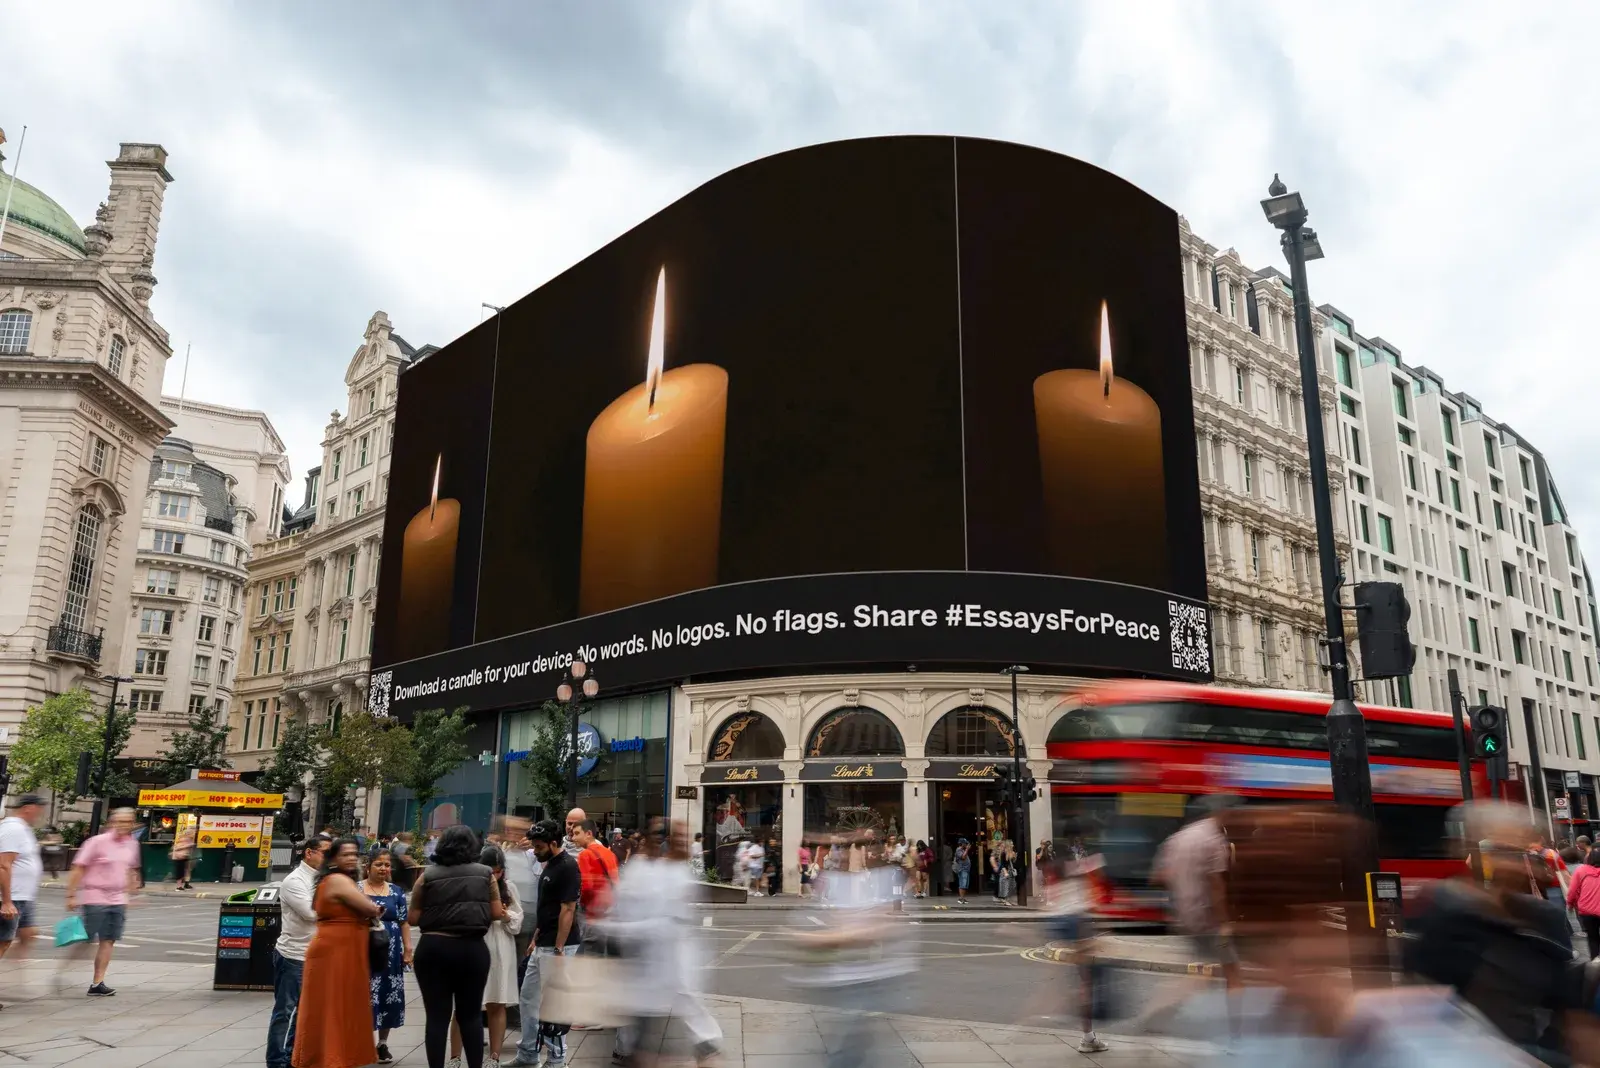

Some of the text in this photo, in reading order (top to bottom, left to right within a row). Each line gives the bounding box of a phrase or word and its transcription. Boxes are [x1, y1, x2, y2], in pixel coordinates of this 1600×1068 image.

[79, 400, 134, 444] ALLIANCE LIFE OFFICE
[394, 676, 439, 701] Download
[441, 678, 446, 692] a
[448, 668, 482, 690] candle
[484, 665, 501, 683] for
[503, 661, 530, 683] your
[579, 644, 597, 664] No
[600, 634, 648, 661] words.
[651, 628, 672, 650] No
[676, 620, 730, 647] logos.
[735, 613, 767, 636] No
[772, 609, 846, 635] flags.
[853, 604, 938, 628] Share
[945, 603, 1161, 642] #EssaysForPeace
[611, 735, 645, 753] beauty
[724, 767, 752, 780] Lindt
[831, 764, 866, 778] Lindt
[957, 764, 993, 777] Lindt
[209, 795, 226, 803] HOT
[245, 796, 265, 804] SPOT
